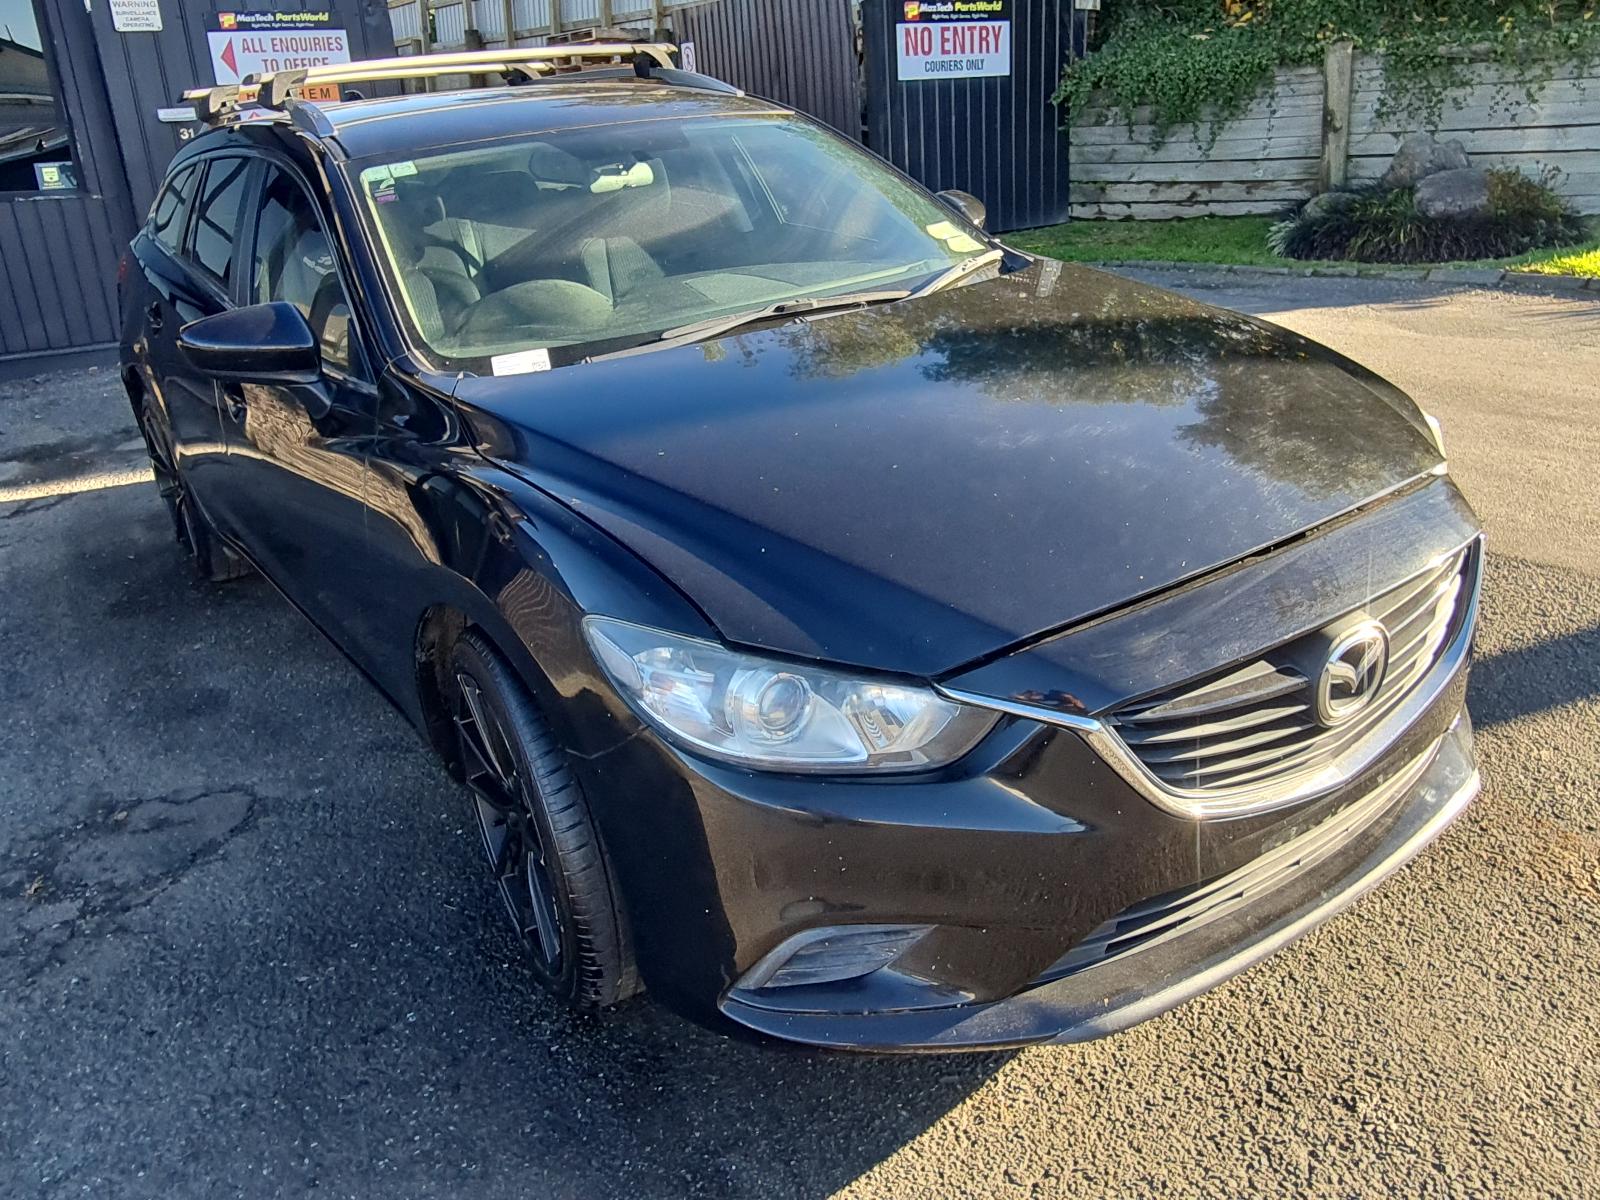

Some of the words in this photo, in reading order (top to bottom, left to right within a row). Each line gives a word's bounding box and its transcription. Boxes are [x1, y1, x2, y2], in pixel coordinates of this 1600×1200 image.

[112, 0, 156, 8] WARNING
[955, 1, 1003, 12] PartsWorld
[275, 11, 329, 22] PartsWorld
[242, 37, 267, 54] ALL
[271, 36, 344, 54] ENQUIRIES
[904, 26, 933, 56] NO
[940, 25, 1003, 56] ENTRY
[261, 58, 280, 73] TO
[924, 59, 964, 73] COURIERS
[966, 58, 985, 71] ONLY
[179, 127, 195, 140] 31
